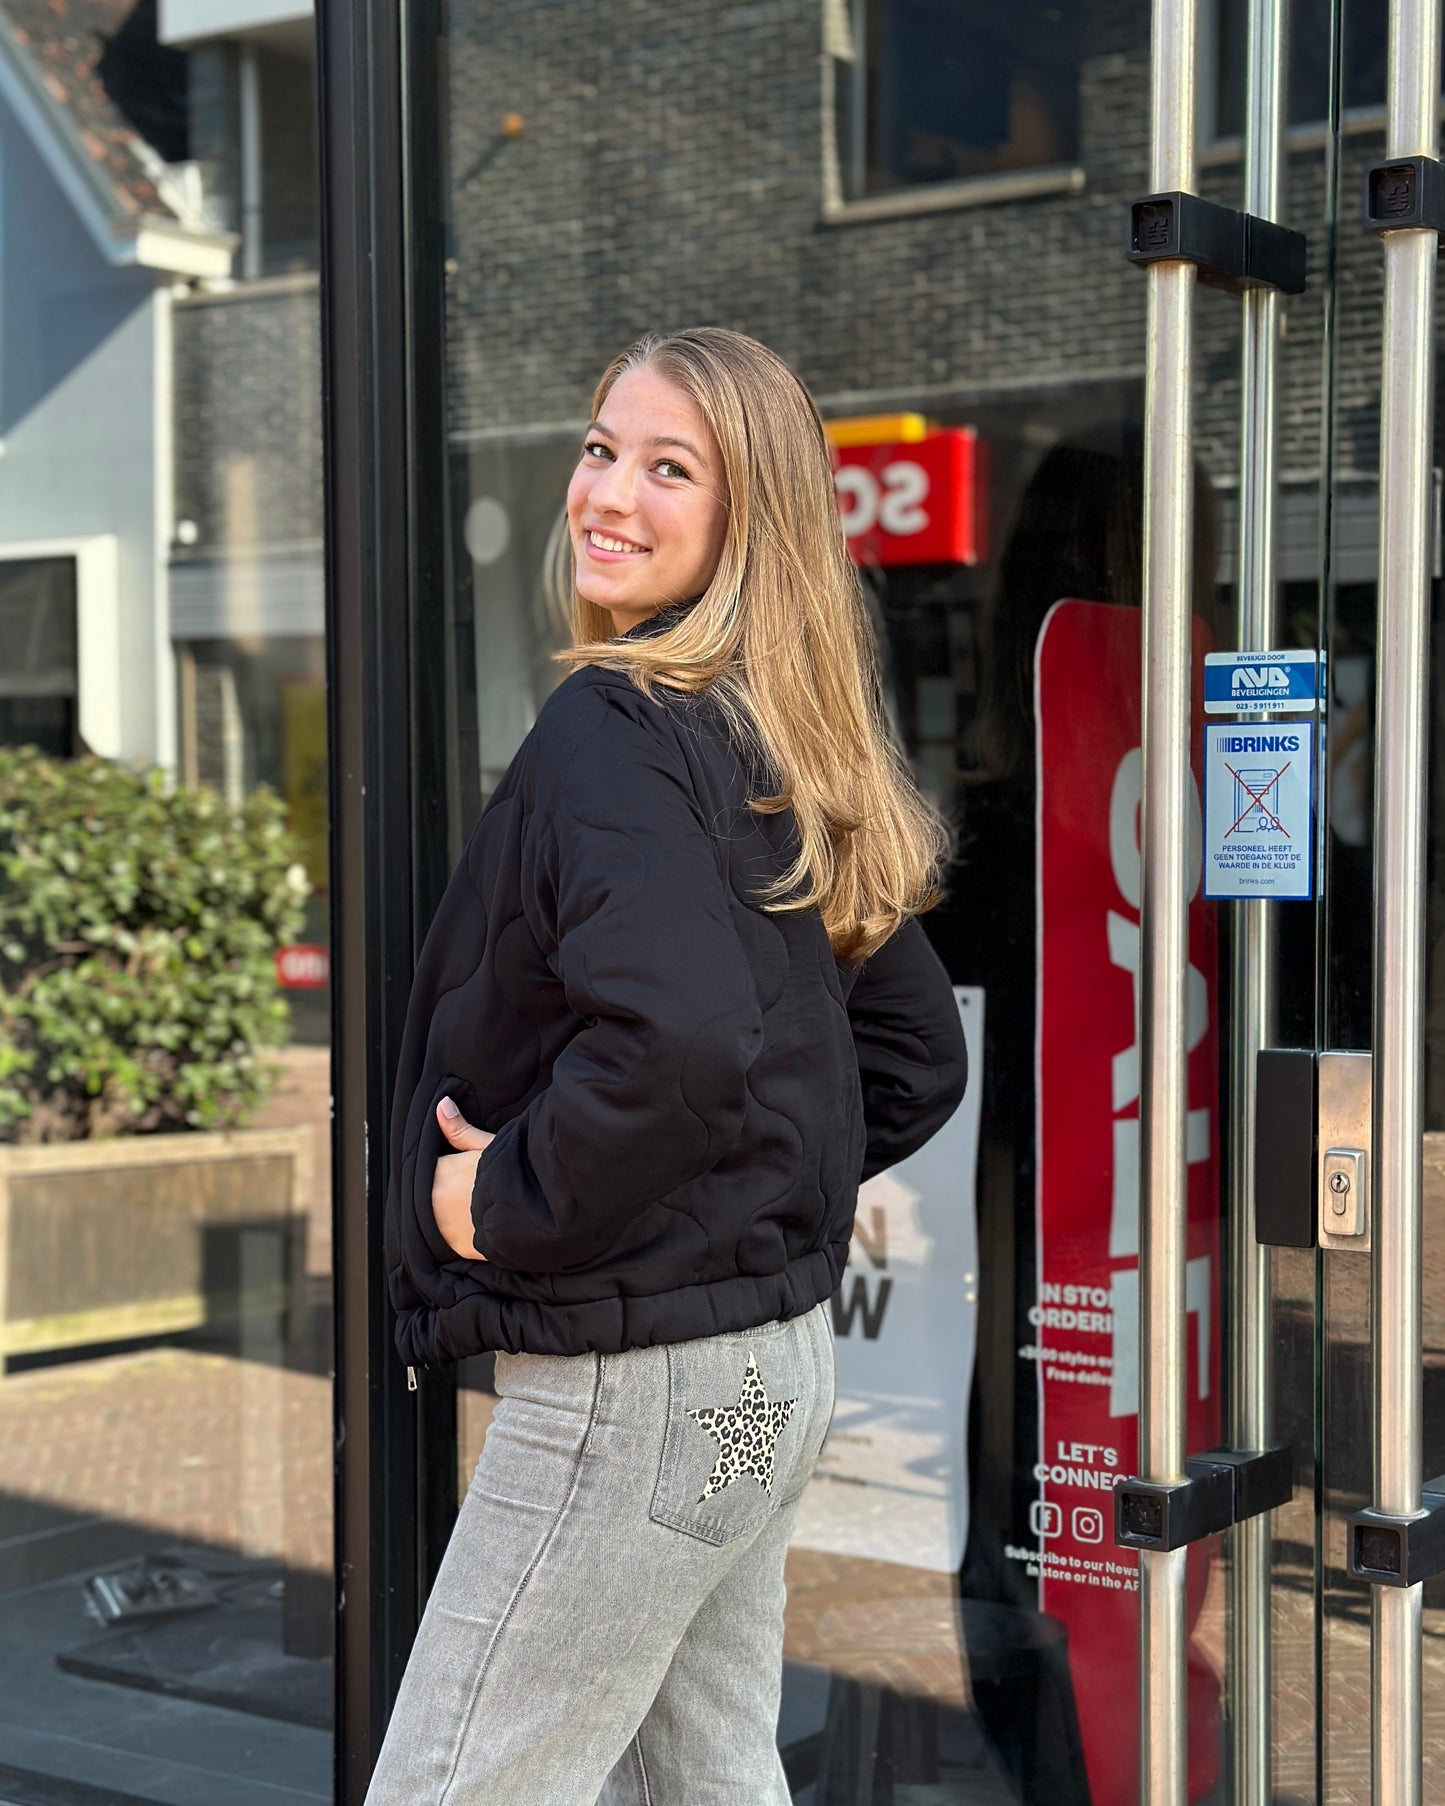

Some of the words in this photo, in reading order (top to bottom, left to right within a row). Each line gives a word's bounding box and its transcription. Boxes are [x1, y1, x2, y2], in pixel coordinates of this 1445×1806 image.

[1232, 688, 1289, 696] BEVEILIGINGEN
[1230, 735, 1300, 753] BRINKS
[1057, 1440, 1119, 1467] LET'S
[1005, 1544, 1067, 1566] Subscribe
[1069, 1557, 1081, 1568] to
[1083, 1561, 1103, 1571] our
[1040, 1568, 1072, 1581] store
[1073, 1574, 1087, 1583] or
[1089, 1573, 1100, 1585] in
[1102, 1576, 1121, 1588] the
